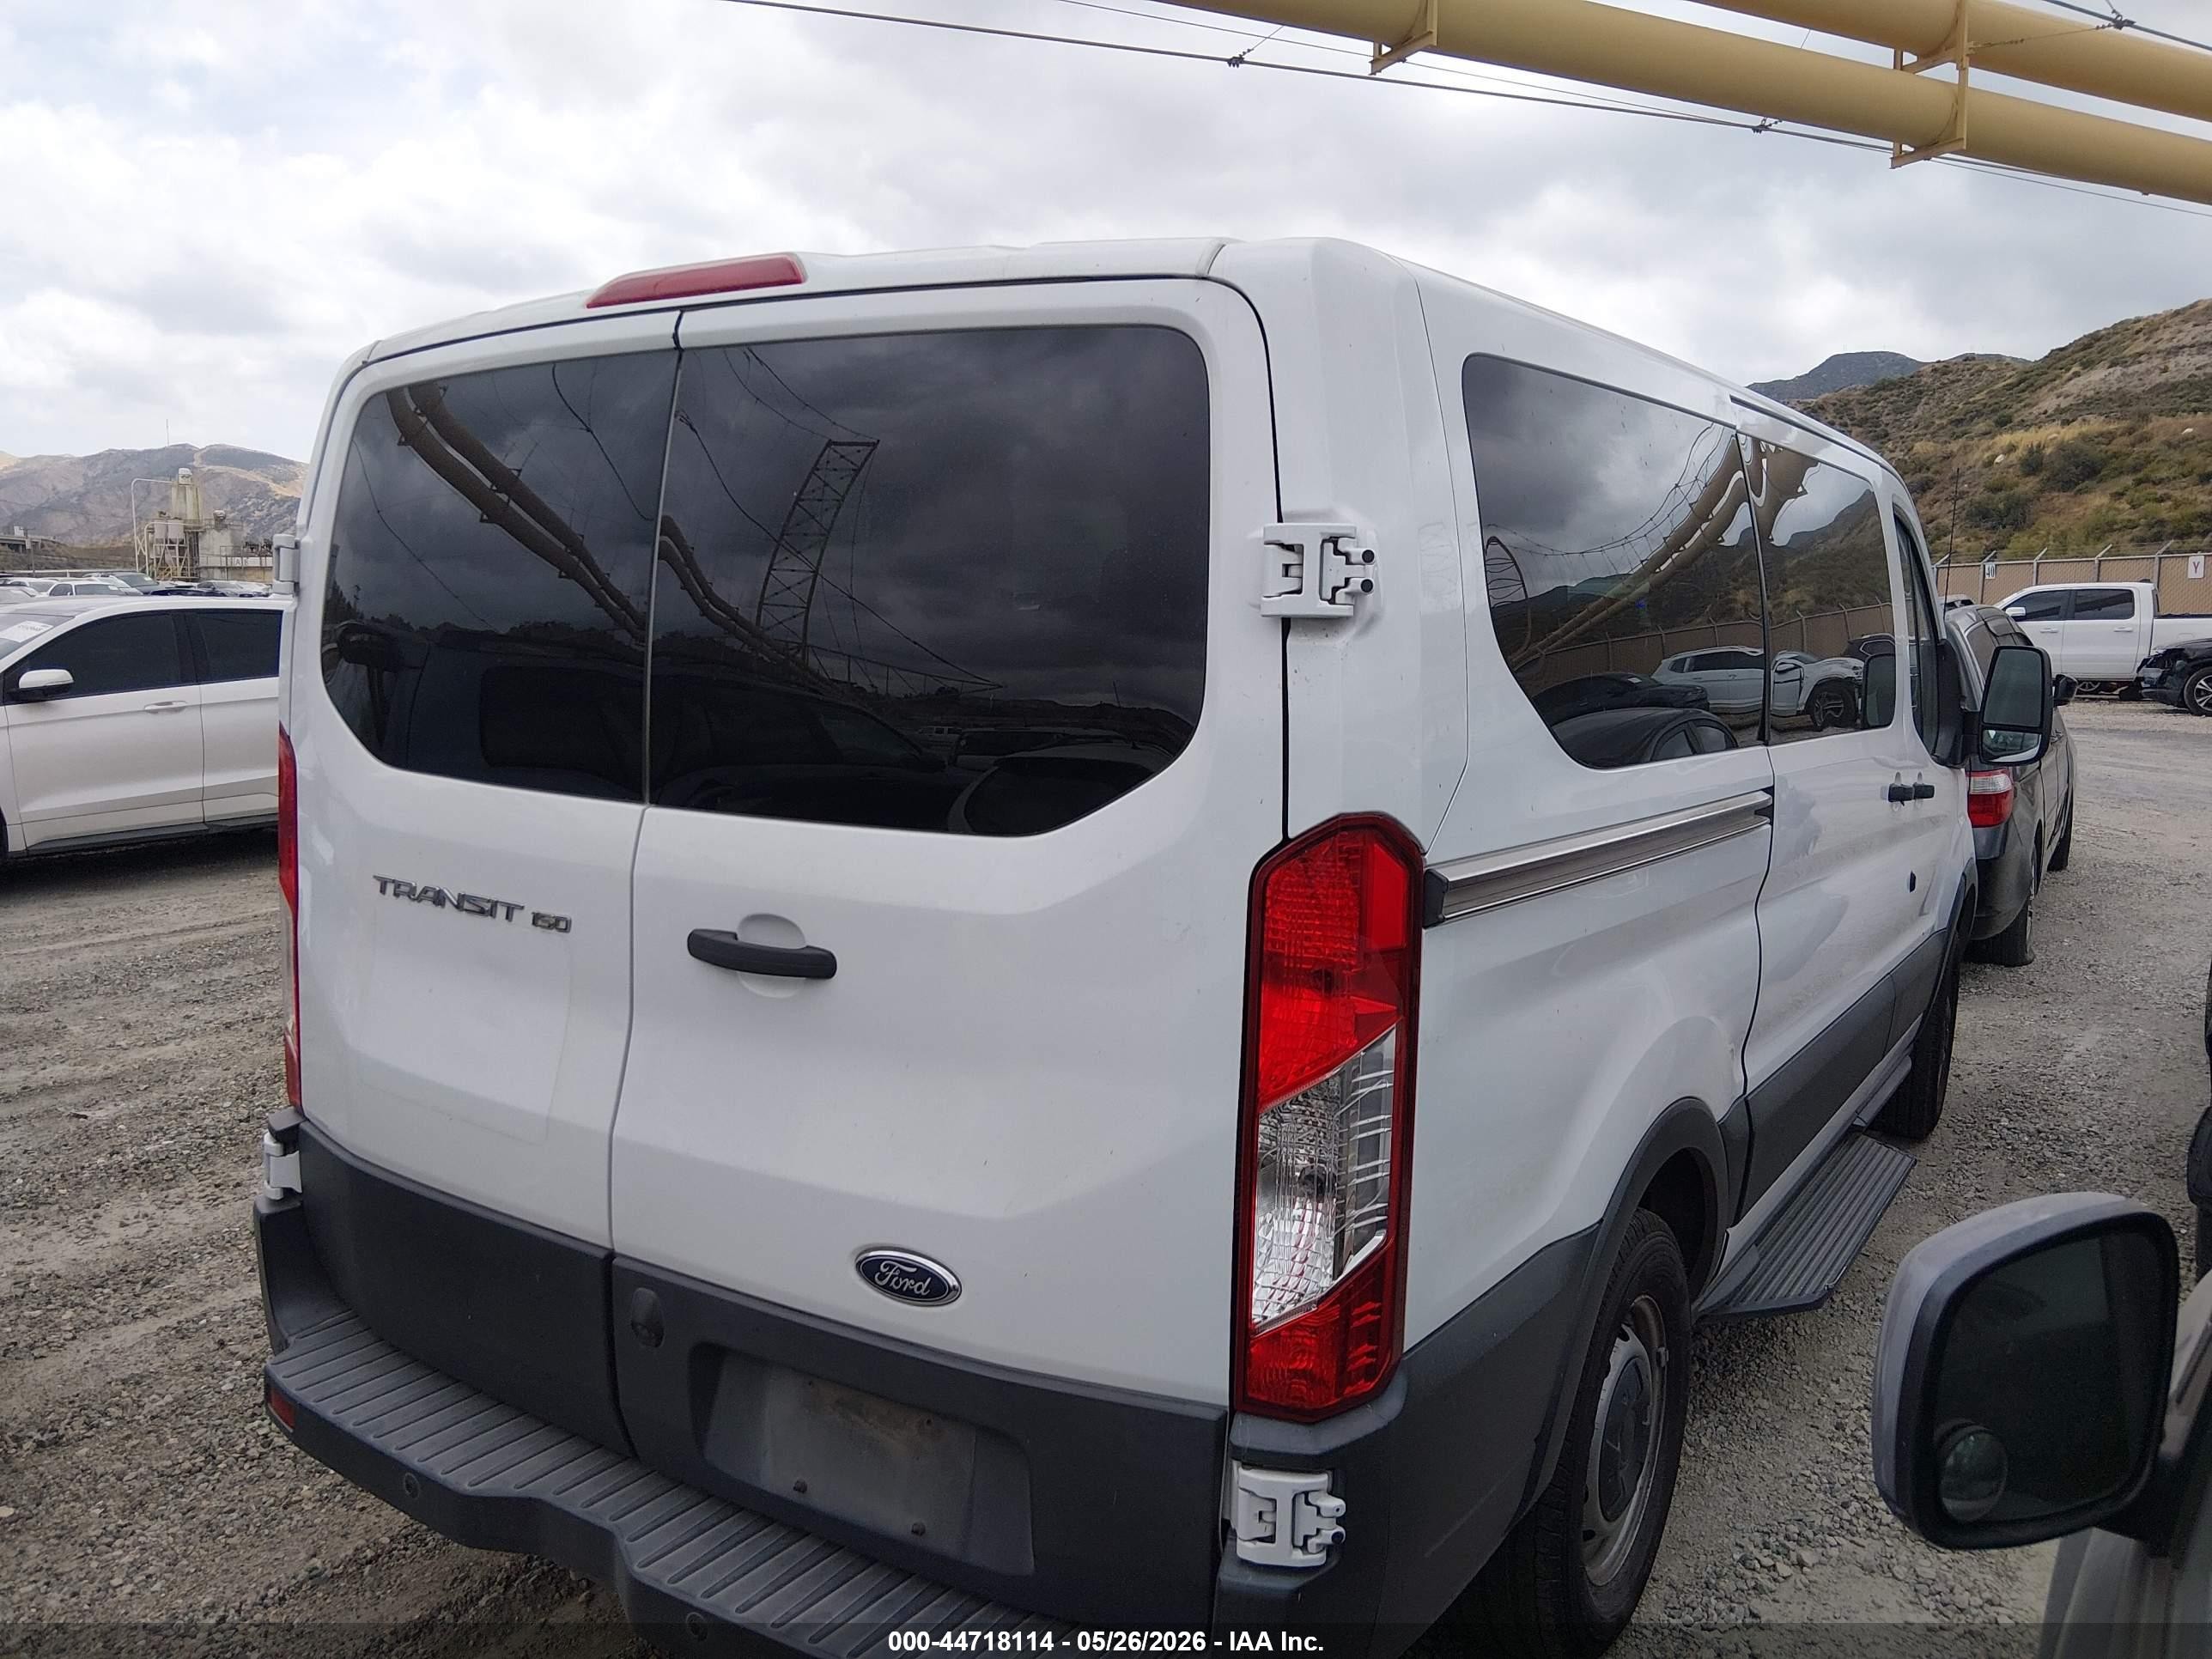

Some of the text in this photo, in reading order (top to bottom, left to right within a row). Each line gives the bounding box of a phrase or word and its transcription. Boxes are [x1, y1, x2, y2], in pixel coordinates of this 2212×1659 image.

[1986, 565, 1995, 578] 40
[2192, 561, 2200, 574] Y
[373, 873, 572, 933] TRANSIT 150
[874, 1260, 932, 1296] Ford
